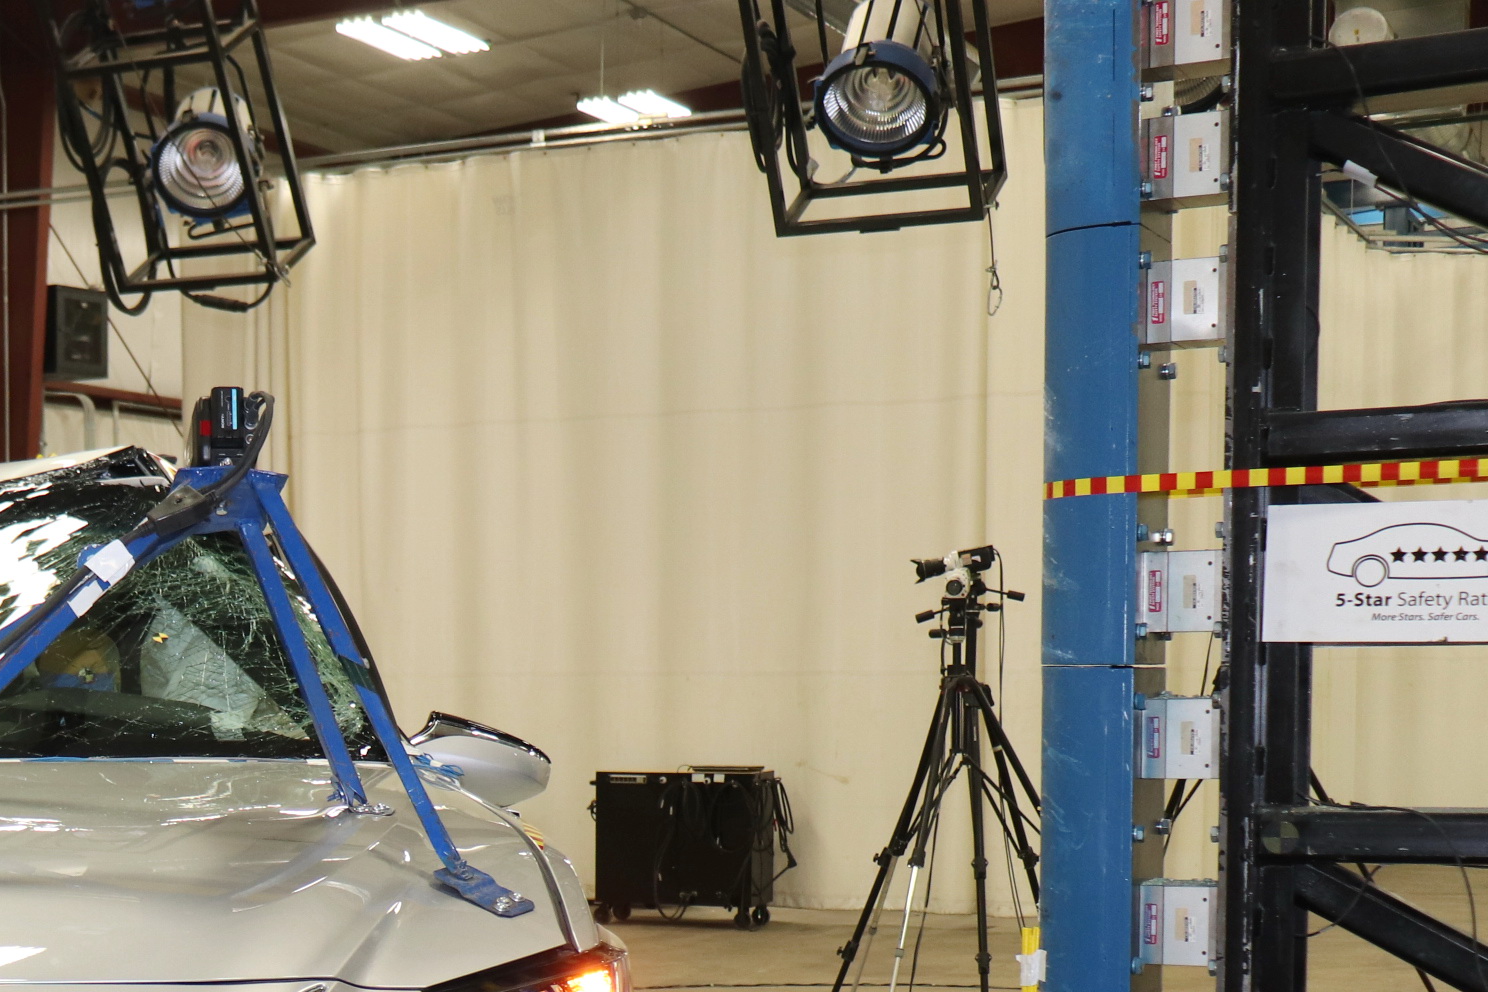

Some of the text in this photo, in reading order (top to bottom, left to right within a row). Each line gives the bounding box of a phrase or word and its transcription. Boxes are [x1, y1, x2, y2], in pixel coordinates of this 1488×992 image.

[1335, 592, 1392, 607] 5-Star
[1397, 591, 1453, 610] Safety
[1371, 612, 1480, 621] More Stars. Safer Cars.
